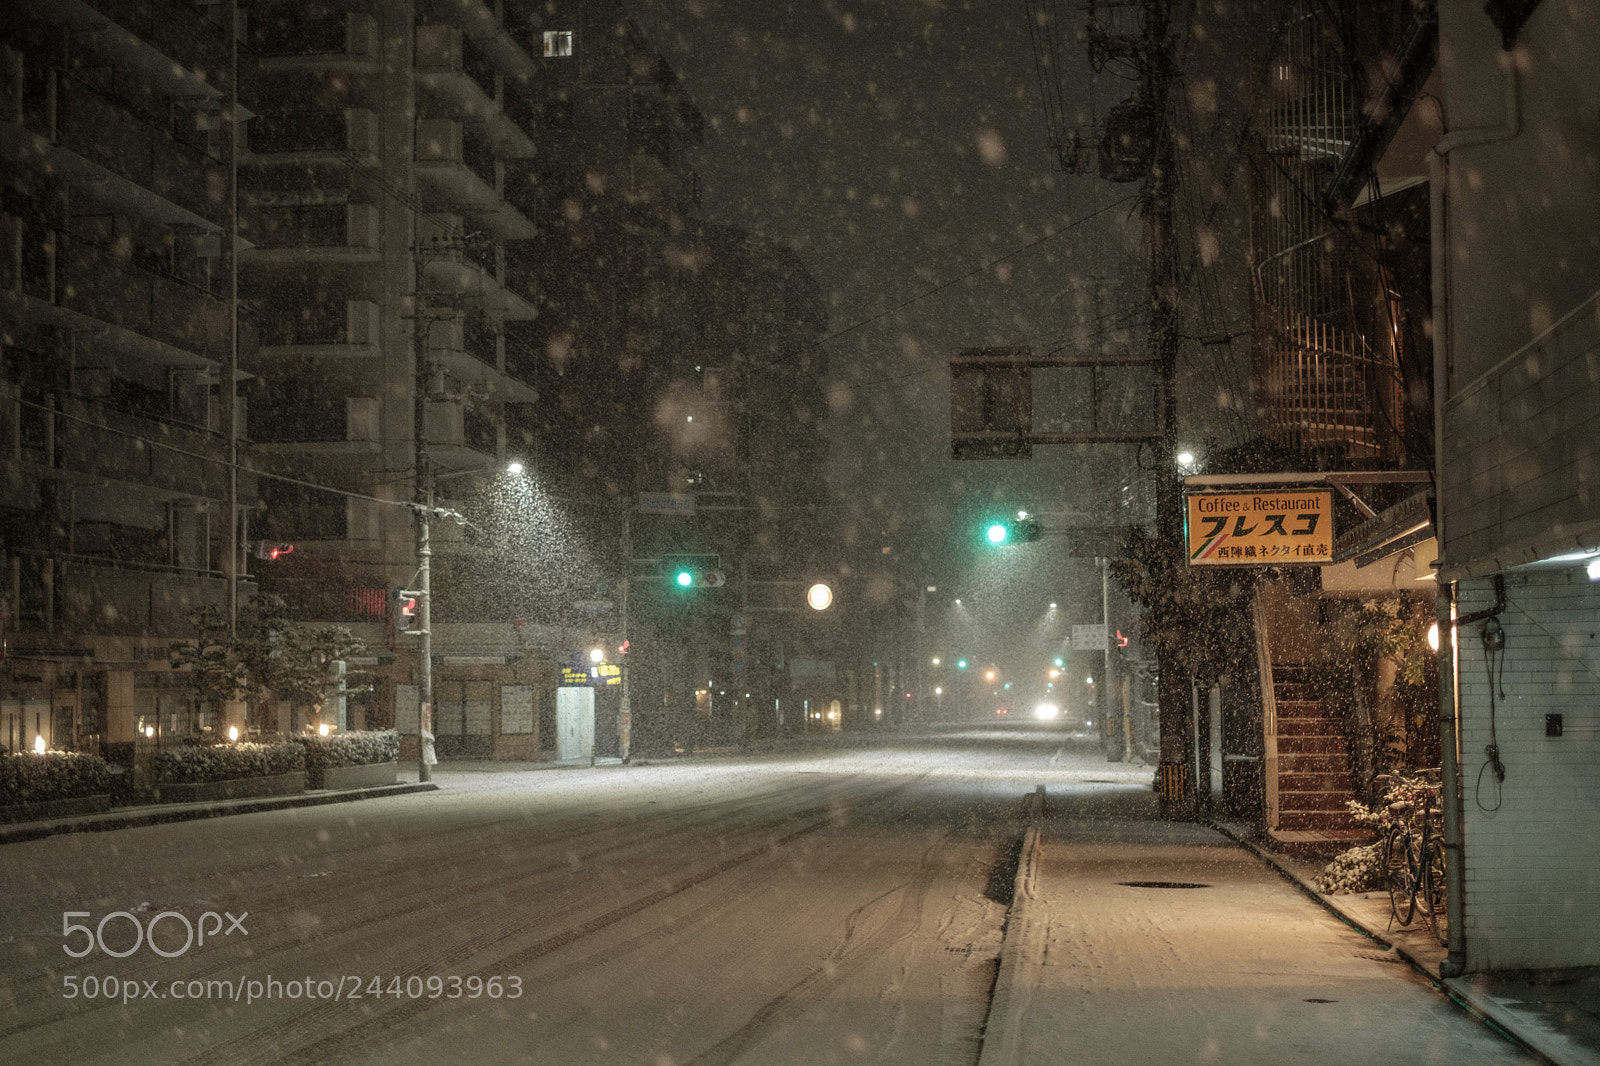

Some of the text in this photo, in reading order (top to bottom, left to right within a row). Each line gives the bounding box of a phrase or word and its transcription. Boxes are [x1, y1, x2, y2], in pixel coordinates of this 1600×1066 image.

[1198, 496, 1321, 513] Coffee & Restaurant
[1200, 513, 1321, 538] フレスコ
[1217, 543, 1328, 559] 西陣織ネクタイ直売
